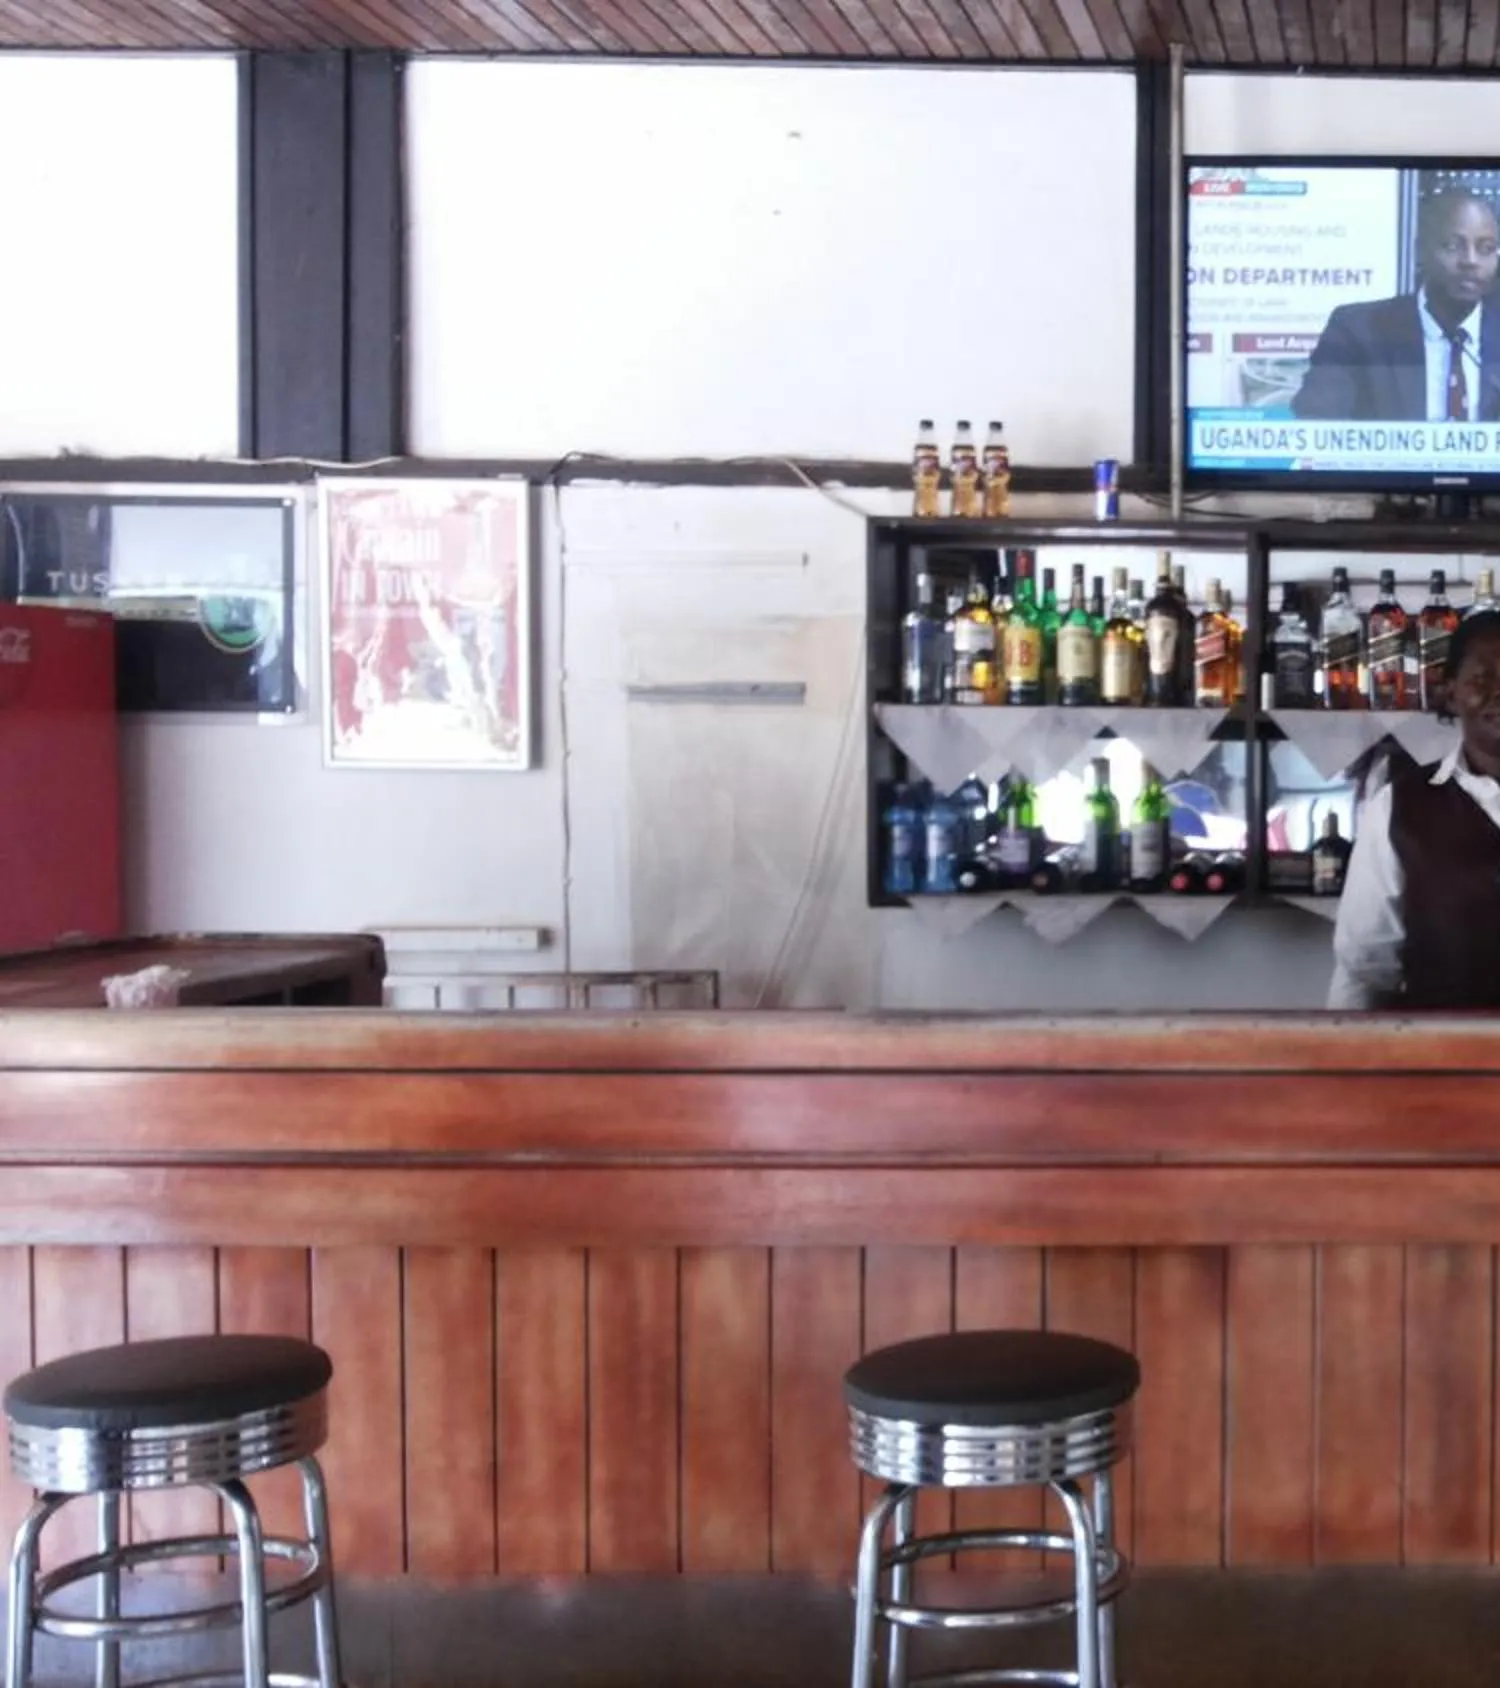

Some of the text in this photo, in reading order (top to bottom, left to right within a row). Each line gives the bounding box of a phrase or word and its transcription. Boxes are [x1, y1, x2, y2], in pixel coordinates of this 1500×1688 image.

[1223, 267, 1375, 286] DEPARTMENT
[1201, 427, 1308, 450] UGANDA'S
[1314, 428, 1426, 451] UNENDING
[1432, 429, 1489, 452] LAND
